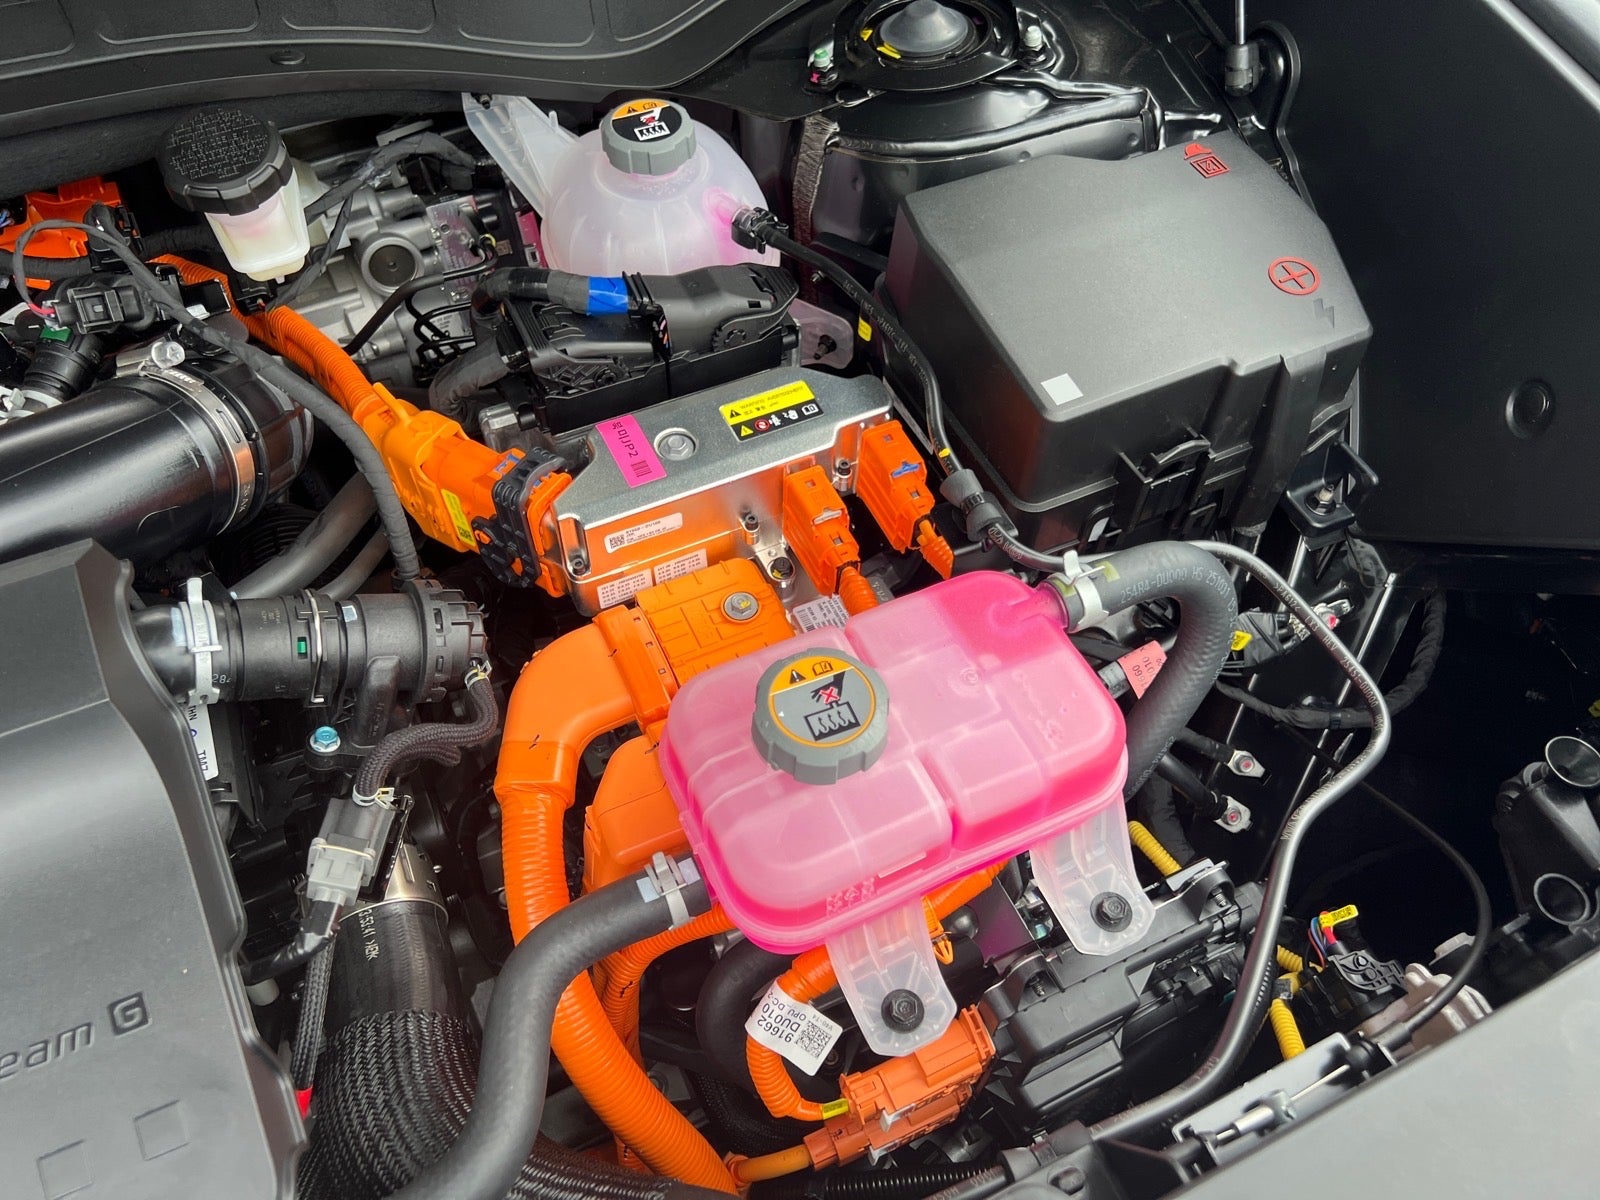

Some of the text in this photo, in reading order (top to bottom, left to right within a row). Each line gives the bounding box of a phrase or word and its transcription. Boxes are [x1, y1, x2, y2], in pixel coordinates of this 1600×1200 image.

[1304, 616, 1319, 632] LX3
[1322, 633, 1338, 651] HEV
[757, 1015, 795, 1043] 91662
[762, 1003, 801, 1033] DU010
